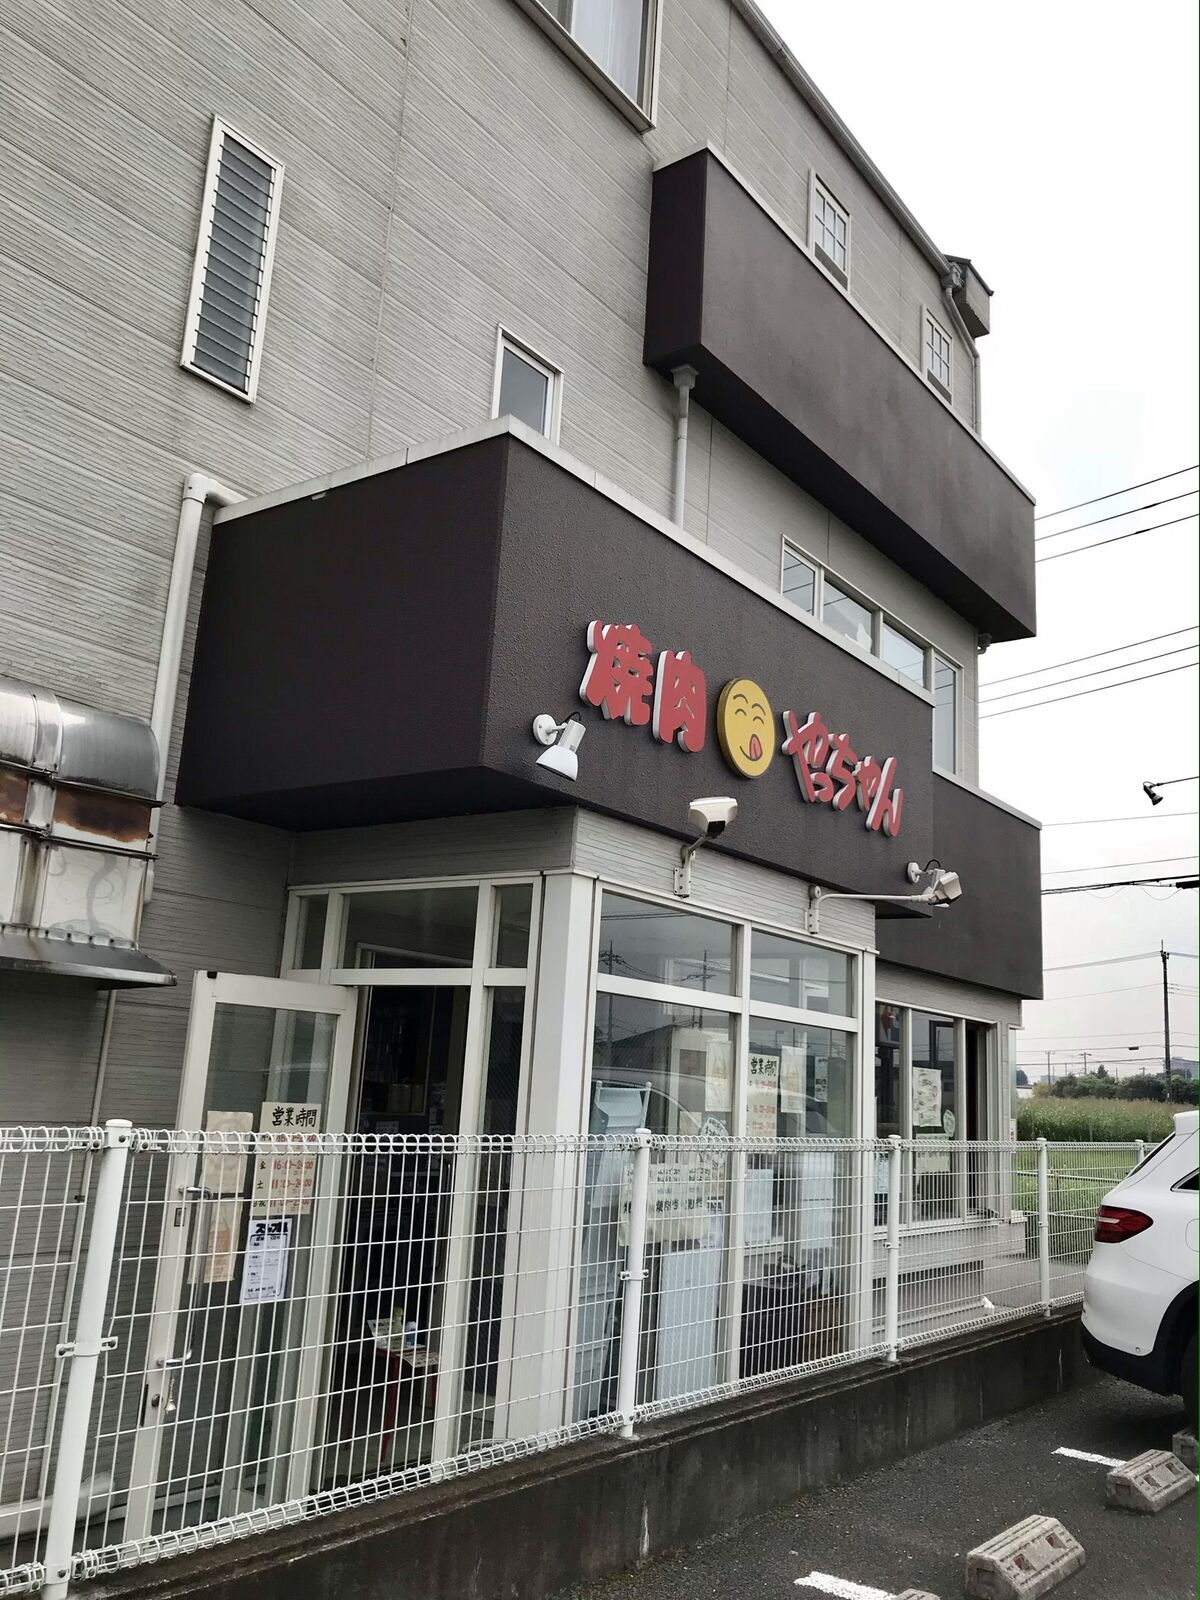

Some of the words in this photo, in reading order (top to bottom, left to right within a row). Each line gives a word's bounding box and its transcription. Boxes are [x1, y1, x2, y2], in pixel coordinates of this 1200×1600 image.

[579, 619, 708, 754] 焼肉
[781, 709, 905, 838] やっちゃん
[271, 1105, 318, 1128] 営業時間
[256, 1179, 264, 1190] 土
